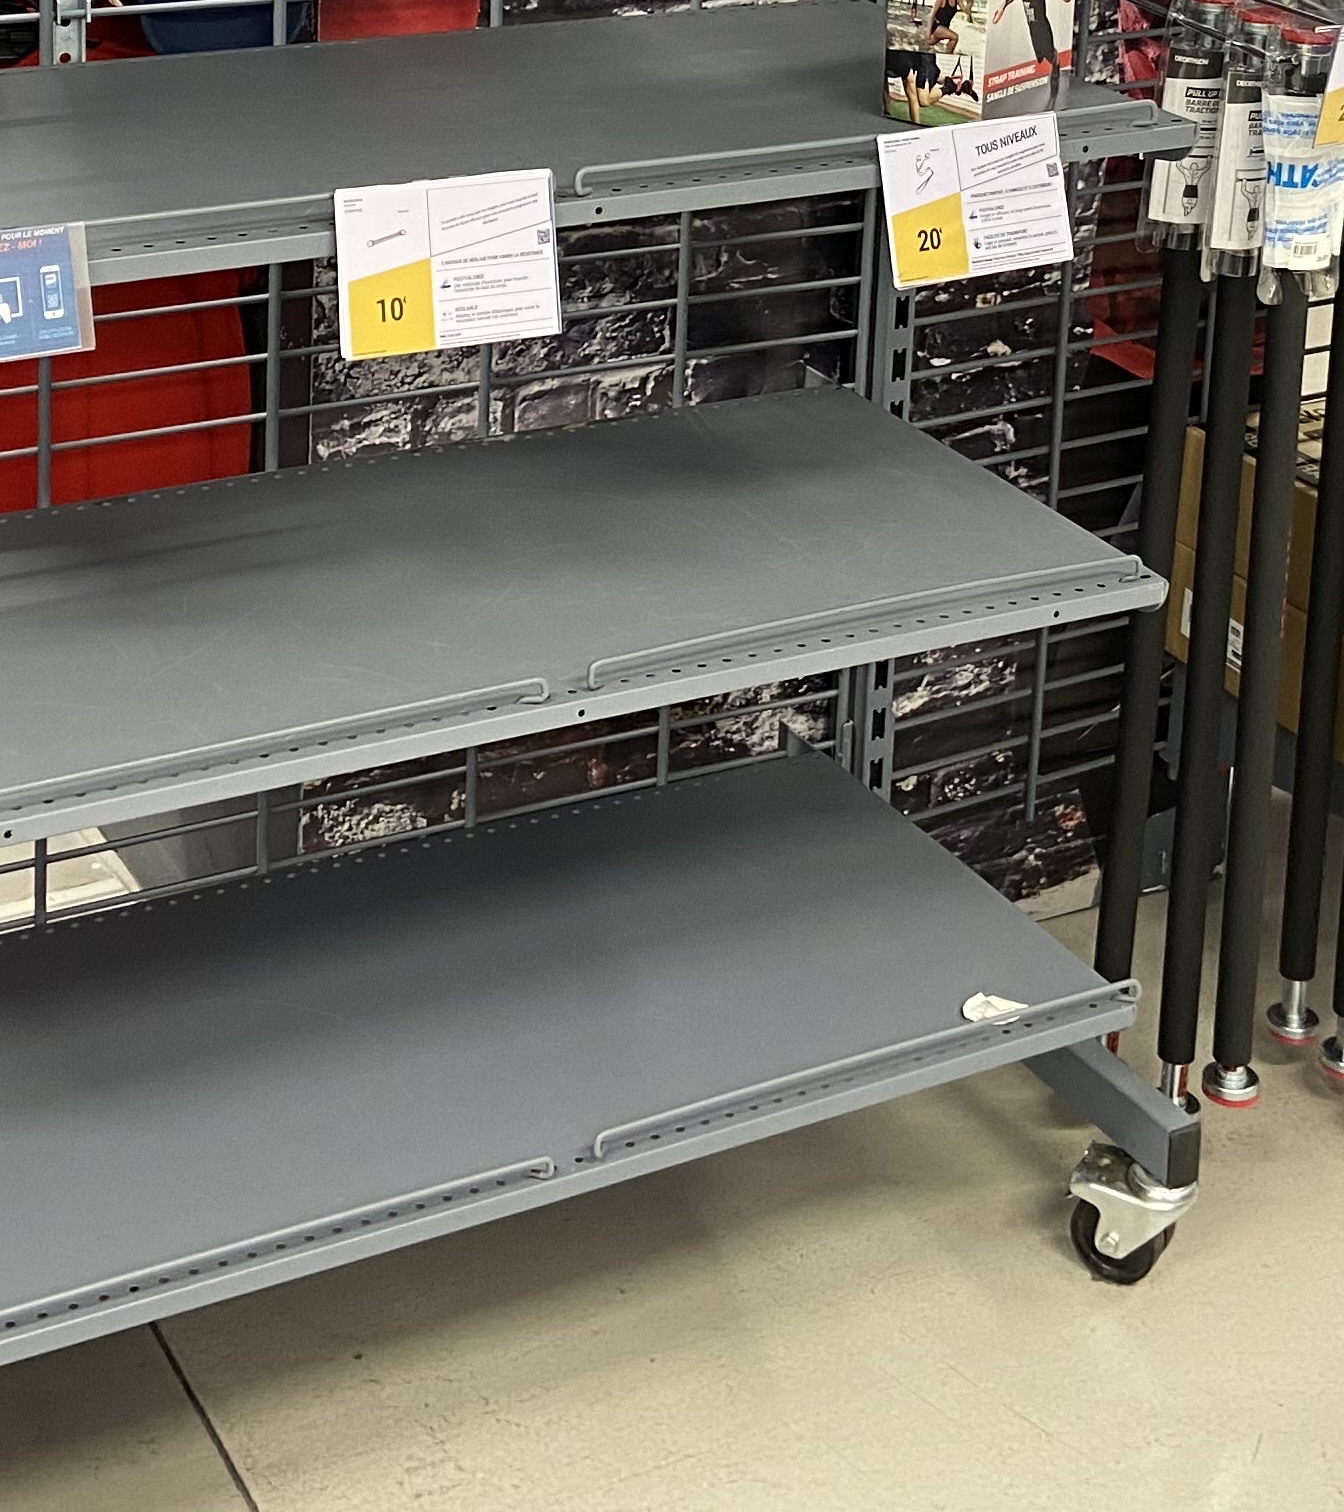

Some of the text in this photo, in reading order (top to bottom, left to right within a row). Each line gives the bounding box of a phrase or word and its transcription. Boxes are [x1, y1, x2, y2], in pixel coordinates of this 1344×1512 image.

[1185, 99, 1211, 107] BARRE
[975, 125, 1038, 157] TOUS NIVEAUX
[1, 231, 22, 241] POUR
[22, 230, 33, 238] LE
[33, 226, 65, 236] MOMENT
[17, 241, 37, 251] MOI
